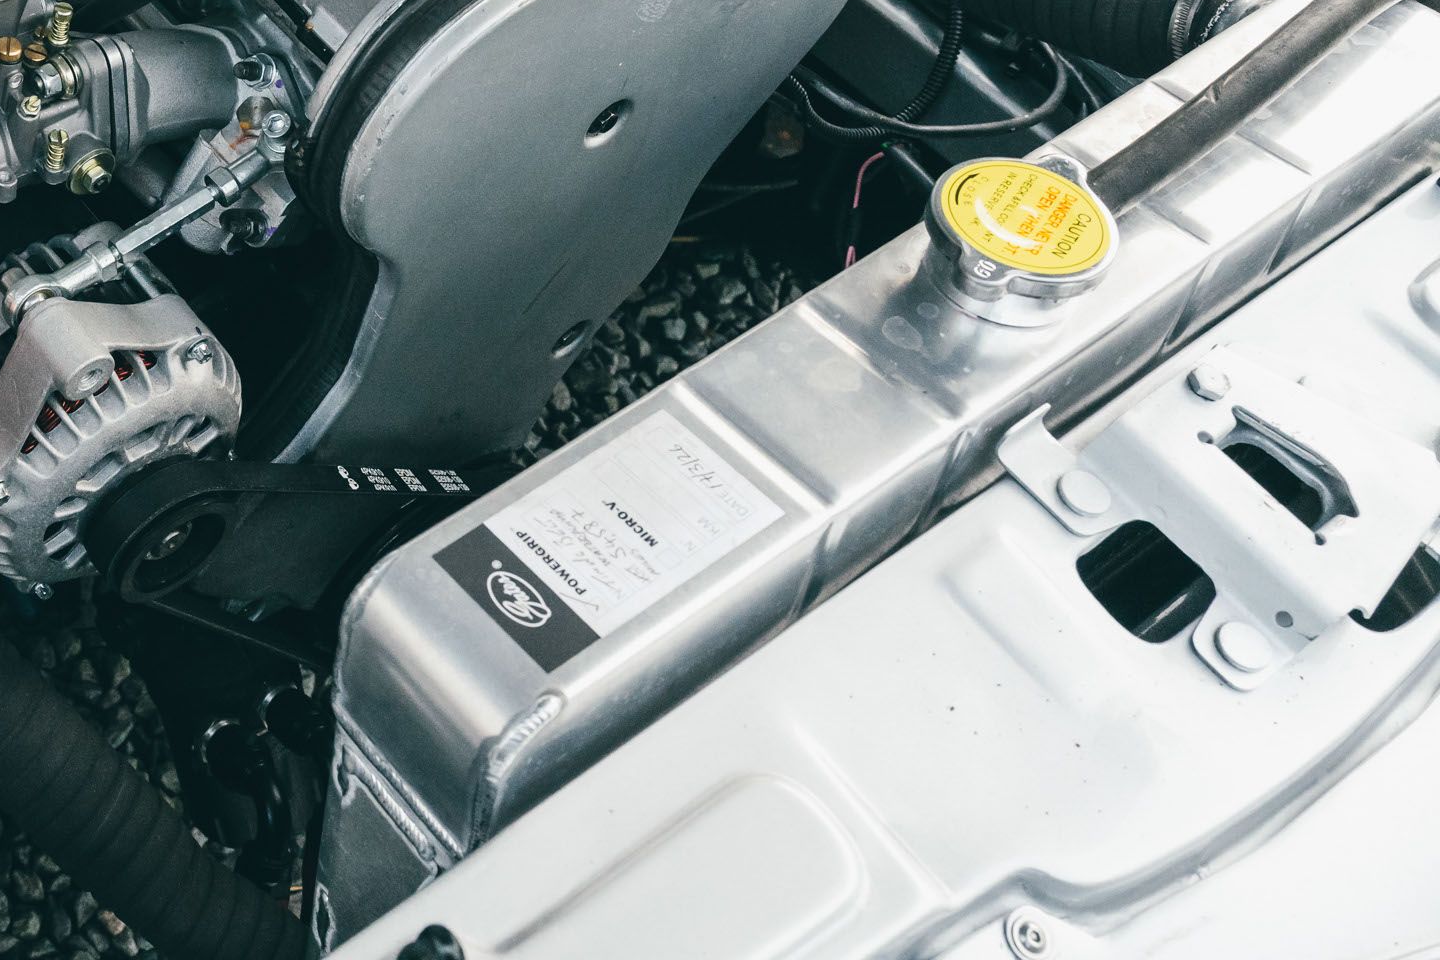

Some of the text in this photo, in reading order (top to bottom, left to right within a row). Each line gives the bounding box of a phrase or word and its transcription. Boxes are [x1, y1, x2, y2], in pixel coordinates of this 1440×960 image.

[1018, 173, 1038, 197] CHECK
[1037, 186, 1060, 211] OPEN
[1023, 192, 1078, 256] DANGER NER
[1051, 213, 1092, 260] CAUTION
[604, 501, 658, 547] MICRO-V
[715, 489, 749, 517] DATE
[515, 531, 588, 595] POWERGRIP
[497, 574, 551, 621] Gates
